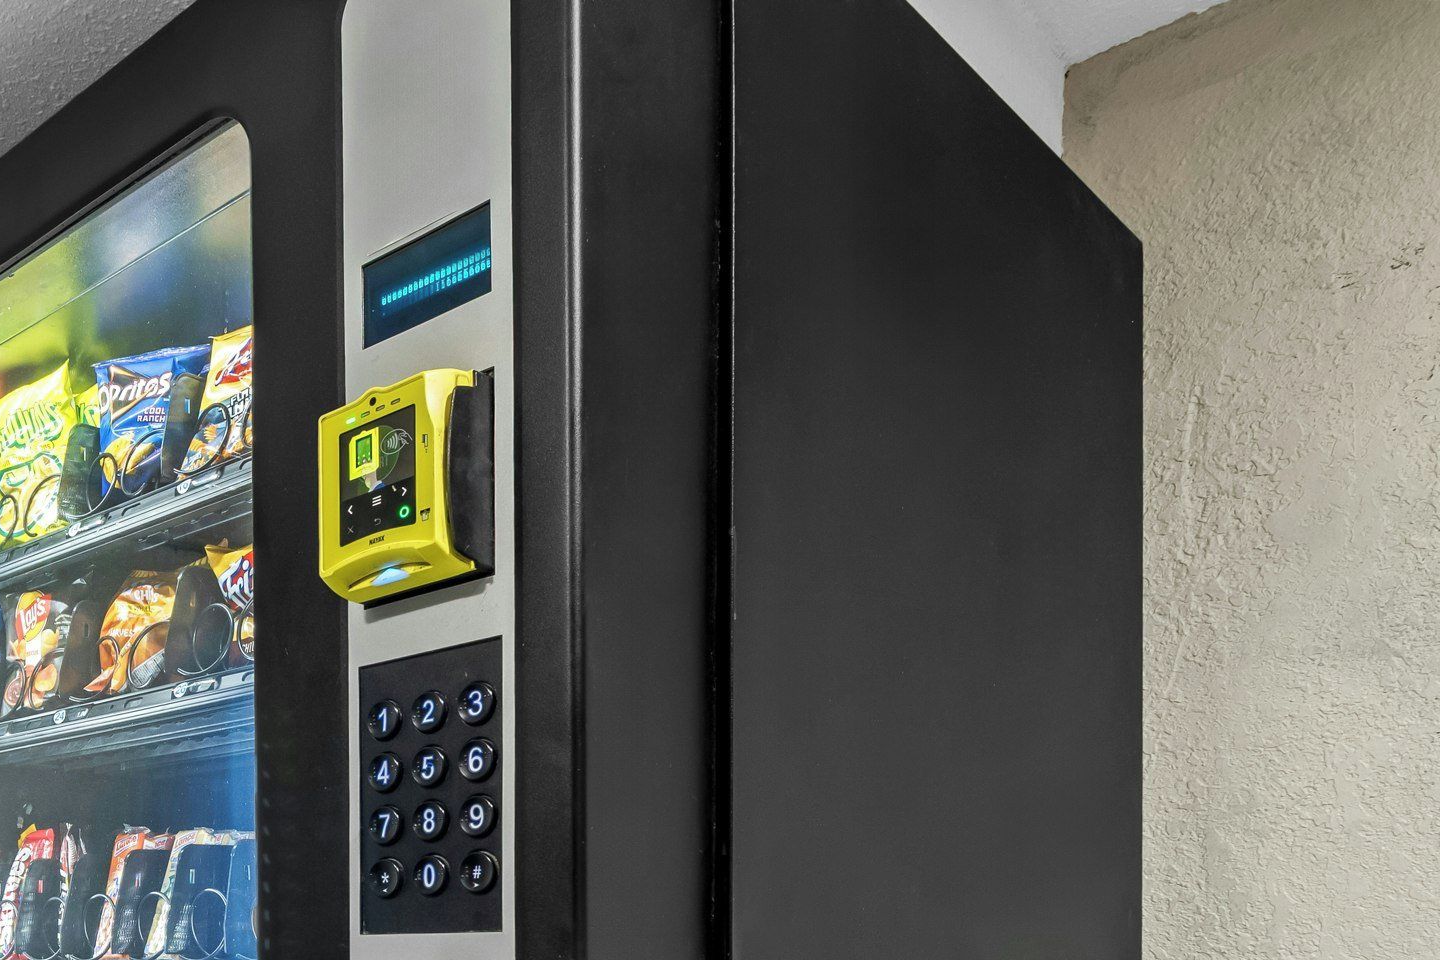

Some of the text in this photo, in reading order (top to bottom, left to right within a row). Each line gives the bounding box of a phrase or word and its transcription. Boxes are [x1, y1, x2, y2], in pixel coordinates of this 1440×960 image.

[99, 371, 172, 415] Doritos
[137, 414, 166, 422] RANCH
[20, 597, 47, 636] Lay's
[421, 700, 435, 724] 2
[468, 690, 483, 716] 3
[55, 712, 65, 723] 24
[378, 708, 388, 732] 1
[377, 760, 390, 784] 4
[421, 755, 435, 780] 5
[468, 746, 483, 773] 6
[378, 814, 391, 838] 7
[422, 808, 436, 833] 8
[469, 804, 484, 829] 9
[423, 863, 436, 888] 0
[472, 864, 482, 879] #
